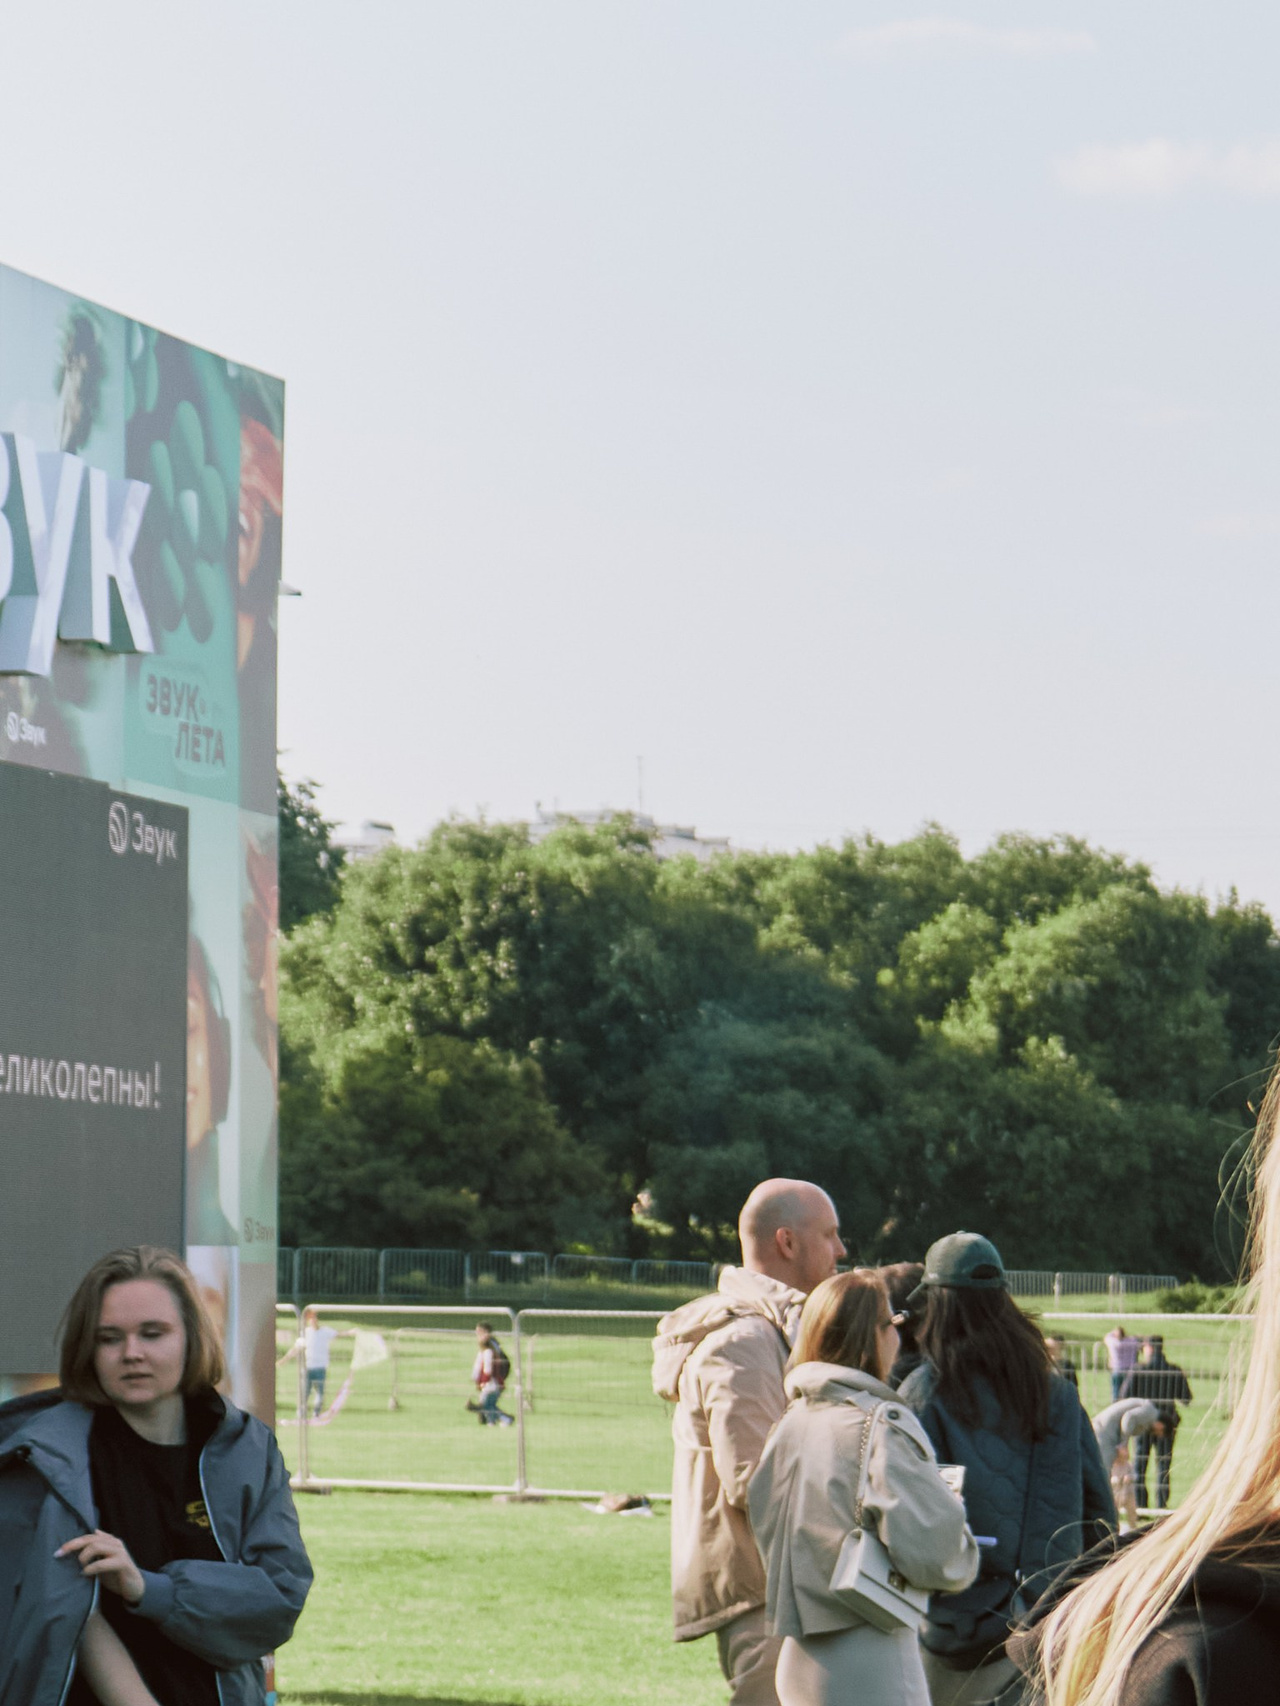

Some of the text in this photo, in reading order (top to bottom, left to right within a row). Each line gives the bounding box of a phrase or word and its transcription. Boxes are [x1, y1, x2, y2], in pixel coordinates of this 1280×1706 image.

[0, 430, 154, 677] УК
[146, 674, 199, 722] ЗВУК
[175, 721, 226, 767] ЛЕТА
[132, 811, 177, 866] Звук
